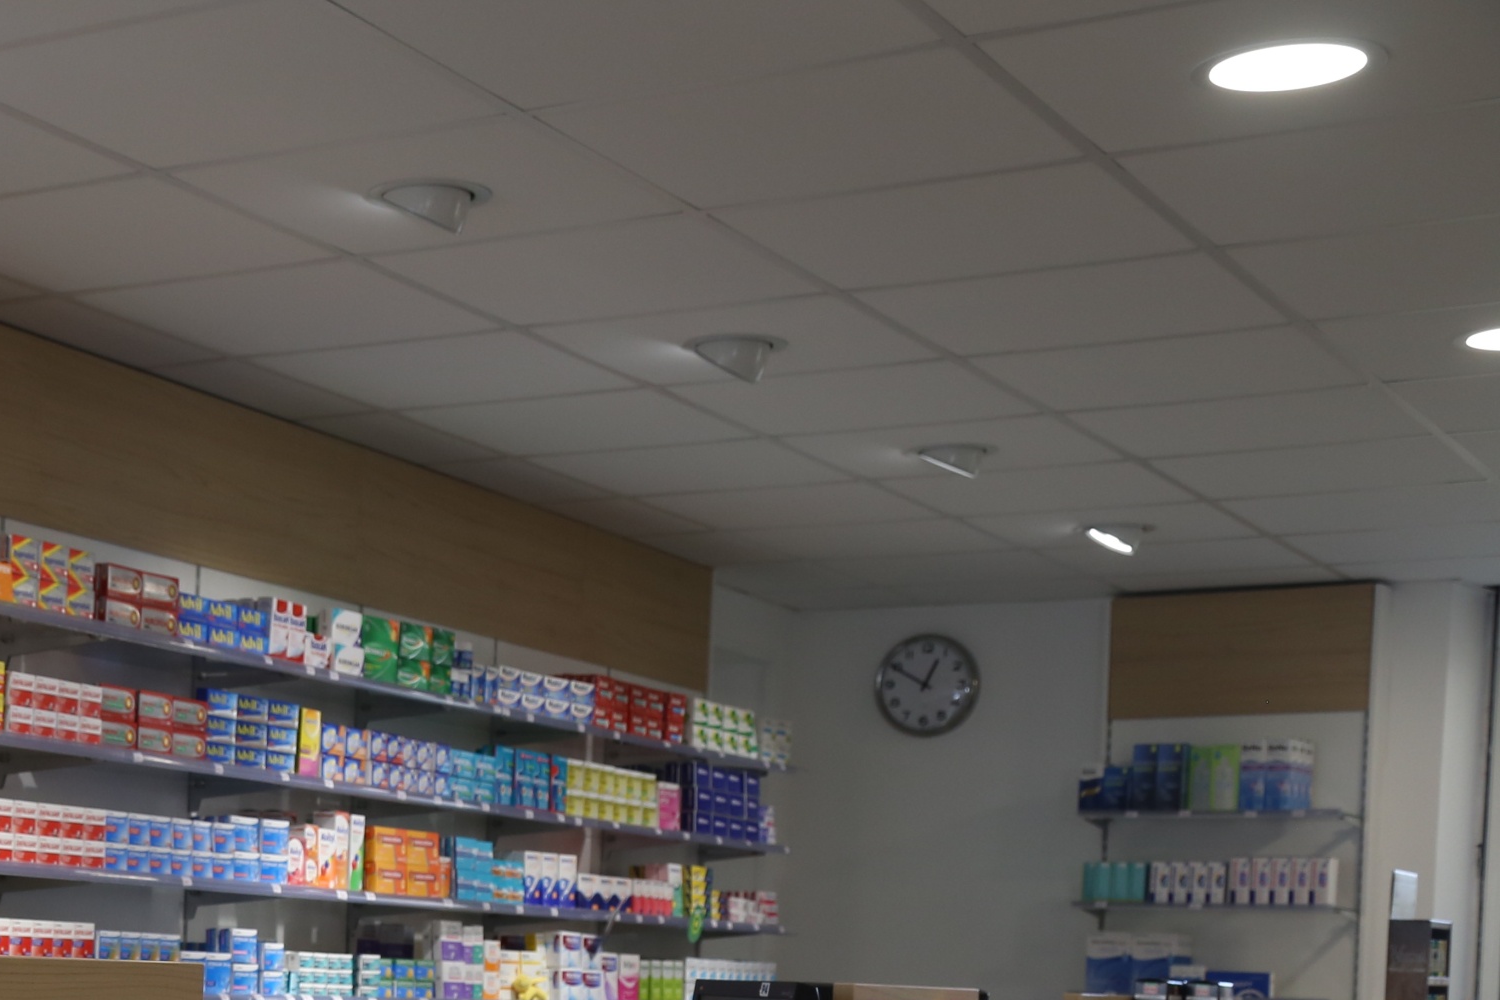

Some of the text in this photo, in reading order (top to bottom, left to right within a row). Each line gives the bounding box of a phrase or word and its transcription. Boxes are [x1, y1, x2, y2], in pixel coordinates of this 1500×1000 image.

[210, 603, 232, 618] Advil
[241, 611, 260, 625] Advil
[211, 630, 233, 644] Advil
